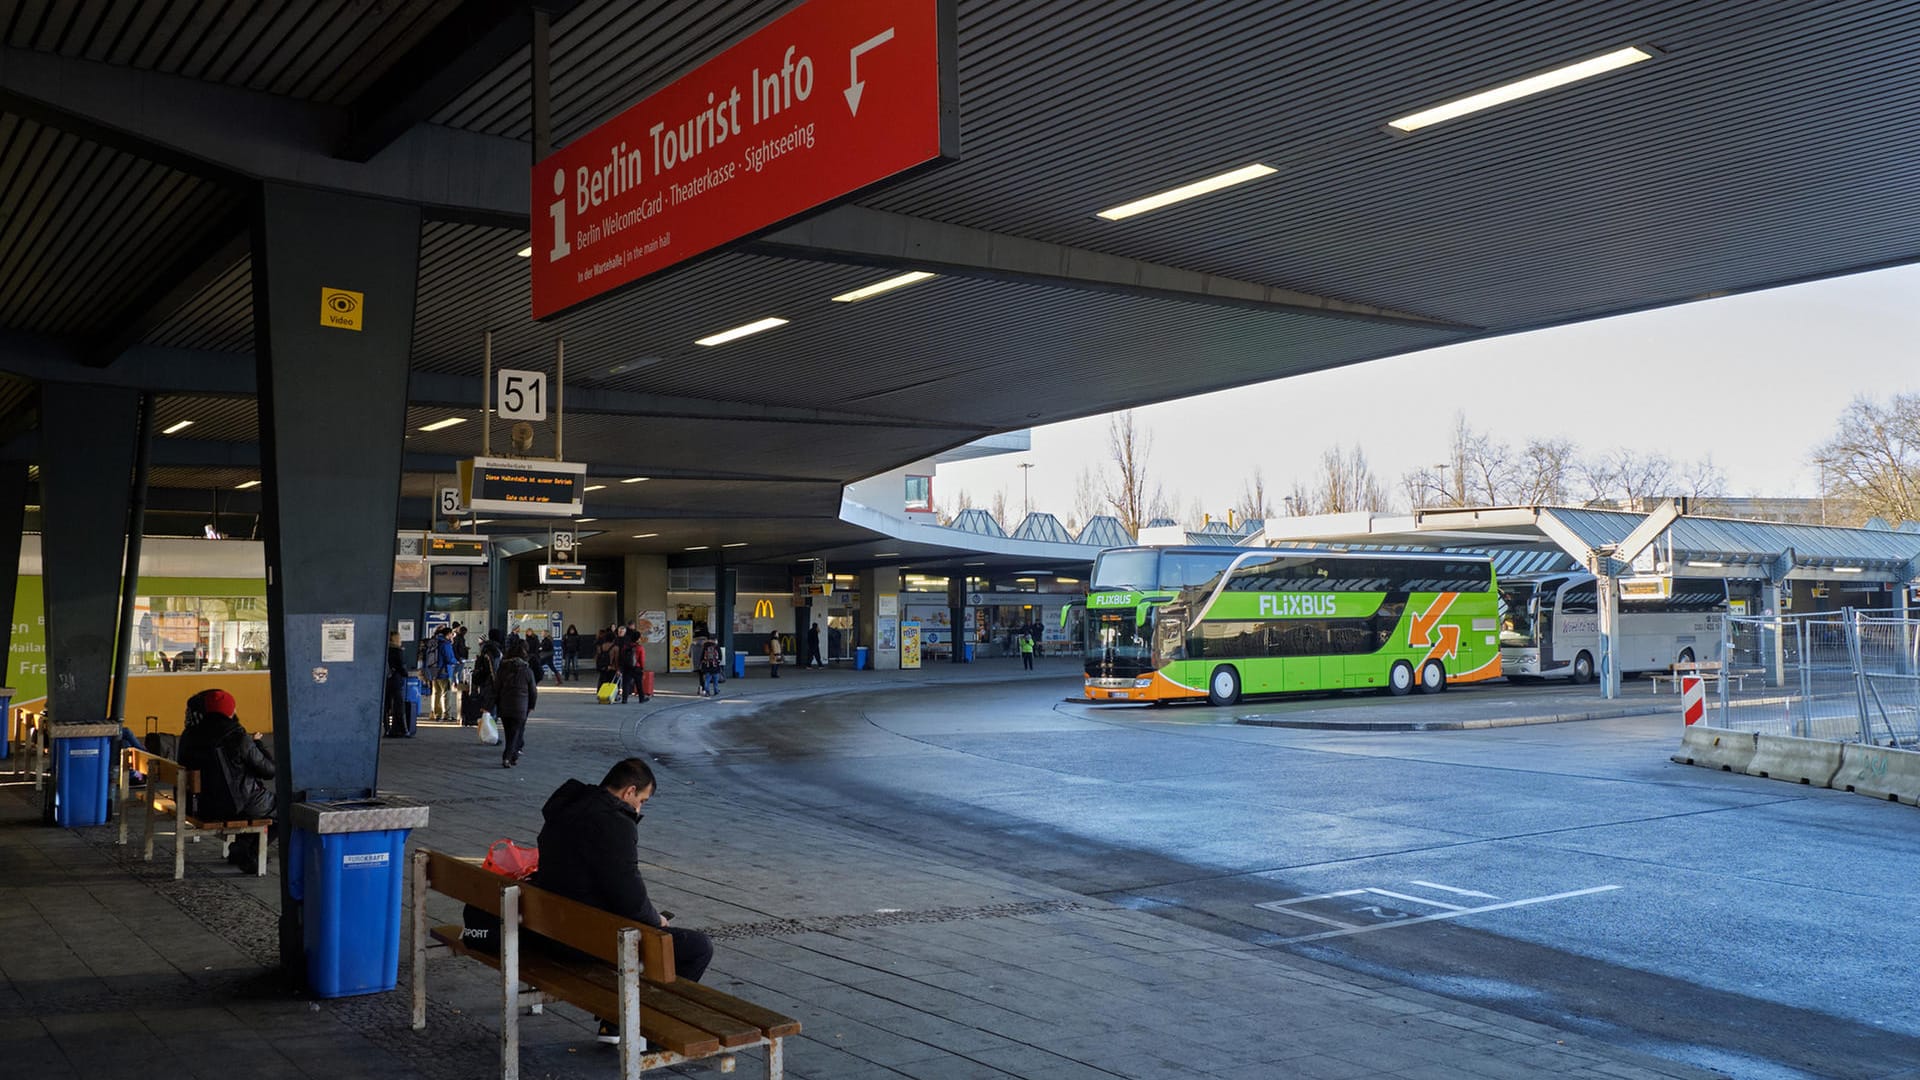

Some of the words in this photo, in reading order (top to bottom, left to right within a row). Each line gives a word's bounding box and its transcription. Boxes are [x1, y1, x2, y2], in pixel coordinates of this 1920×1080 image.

[577, 141, 642, 215] Berlin
[650, 86, 741, 176] Tourist
[753, 45, 814, 125] Info
[577, 218, 601, 250] Berlin
[602, 191, 663, 237] WelcomeCard
[670, 161, 735, 207] Theaterkasse
[745, 122, 815, 172] Sightseeing
[578, 271, 583, 283] In
[584, 267, 593, 280] der
[593, 254, 622, 276] Wartehalle
[627, 247, 633, 262] in
[633, 245, 643, 260] the
[643, 239, 659, 255] main
[659, 231, 671, 249] hall
[329, 315, 354, 326] Video
[504, 377, 540, 413] 51
[556, 534, 570, 548] 53
